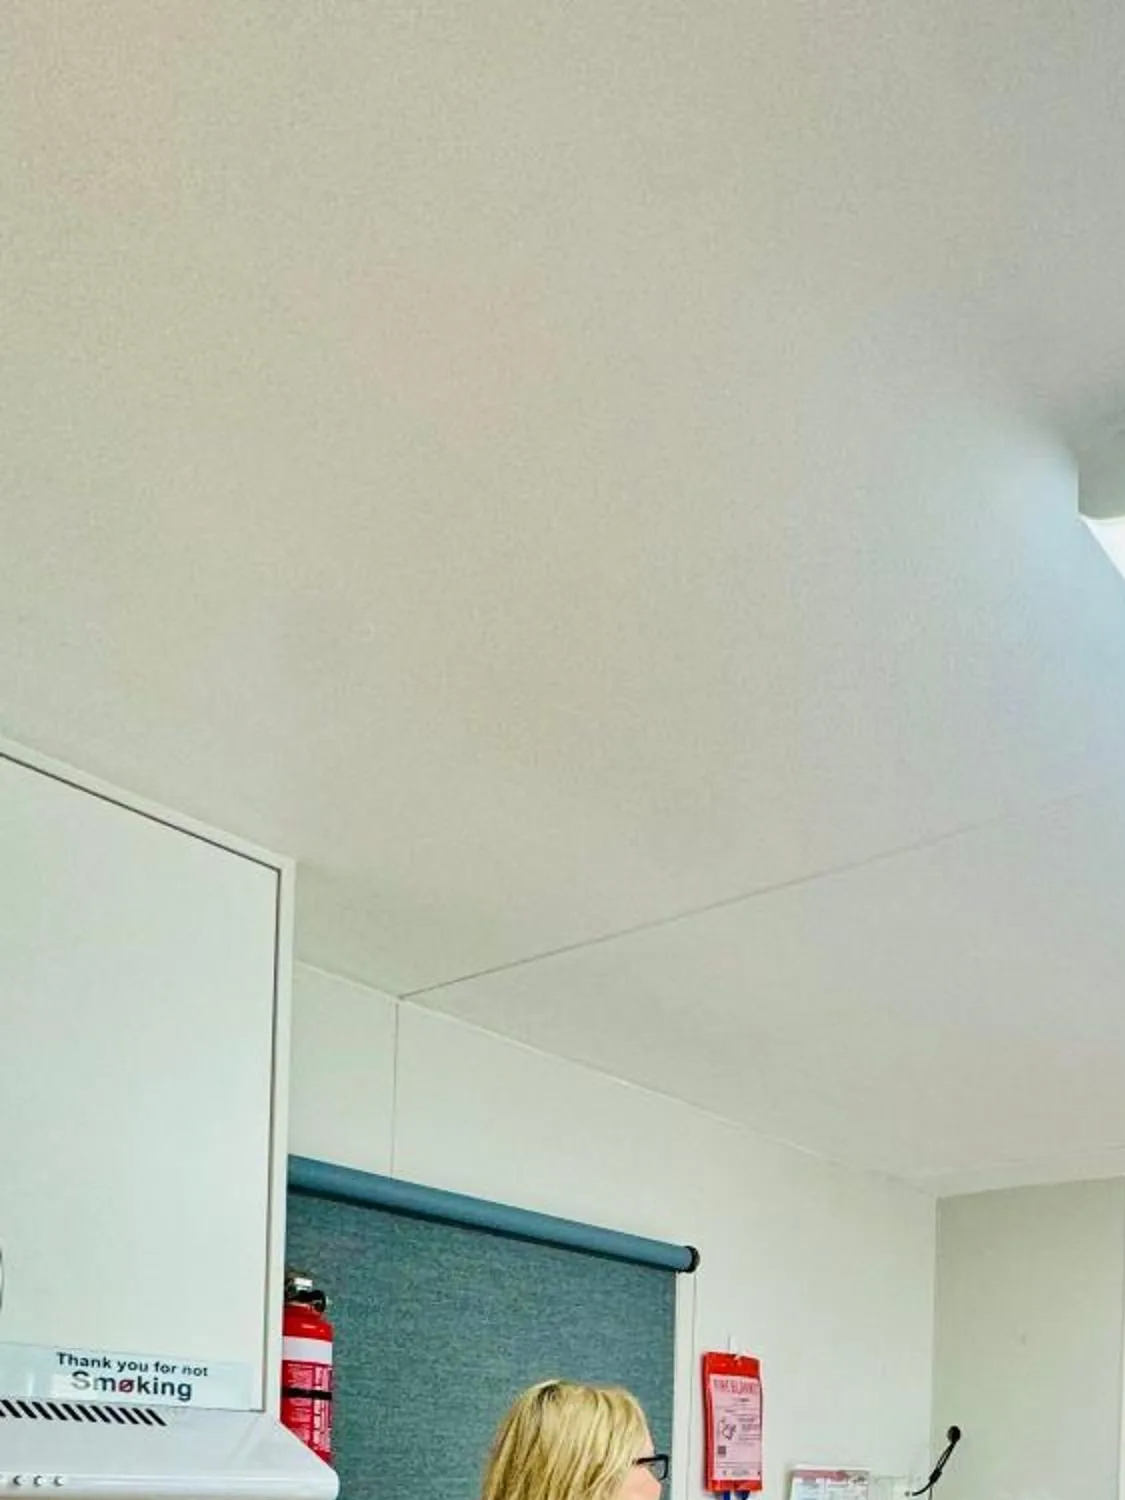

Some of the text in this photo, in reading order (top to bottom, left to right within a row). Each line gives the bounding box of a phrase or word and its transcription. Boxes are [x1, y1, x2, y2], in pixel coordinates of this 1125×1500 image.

[57, 1352, 209, 1377] Thank you for not
